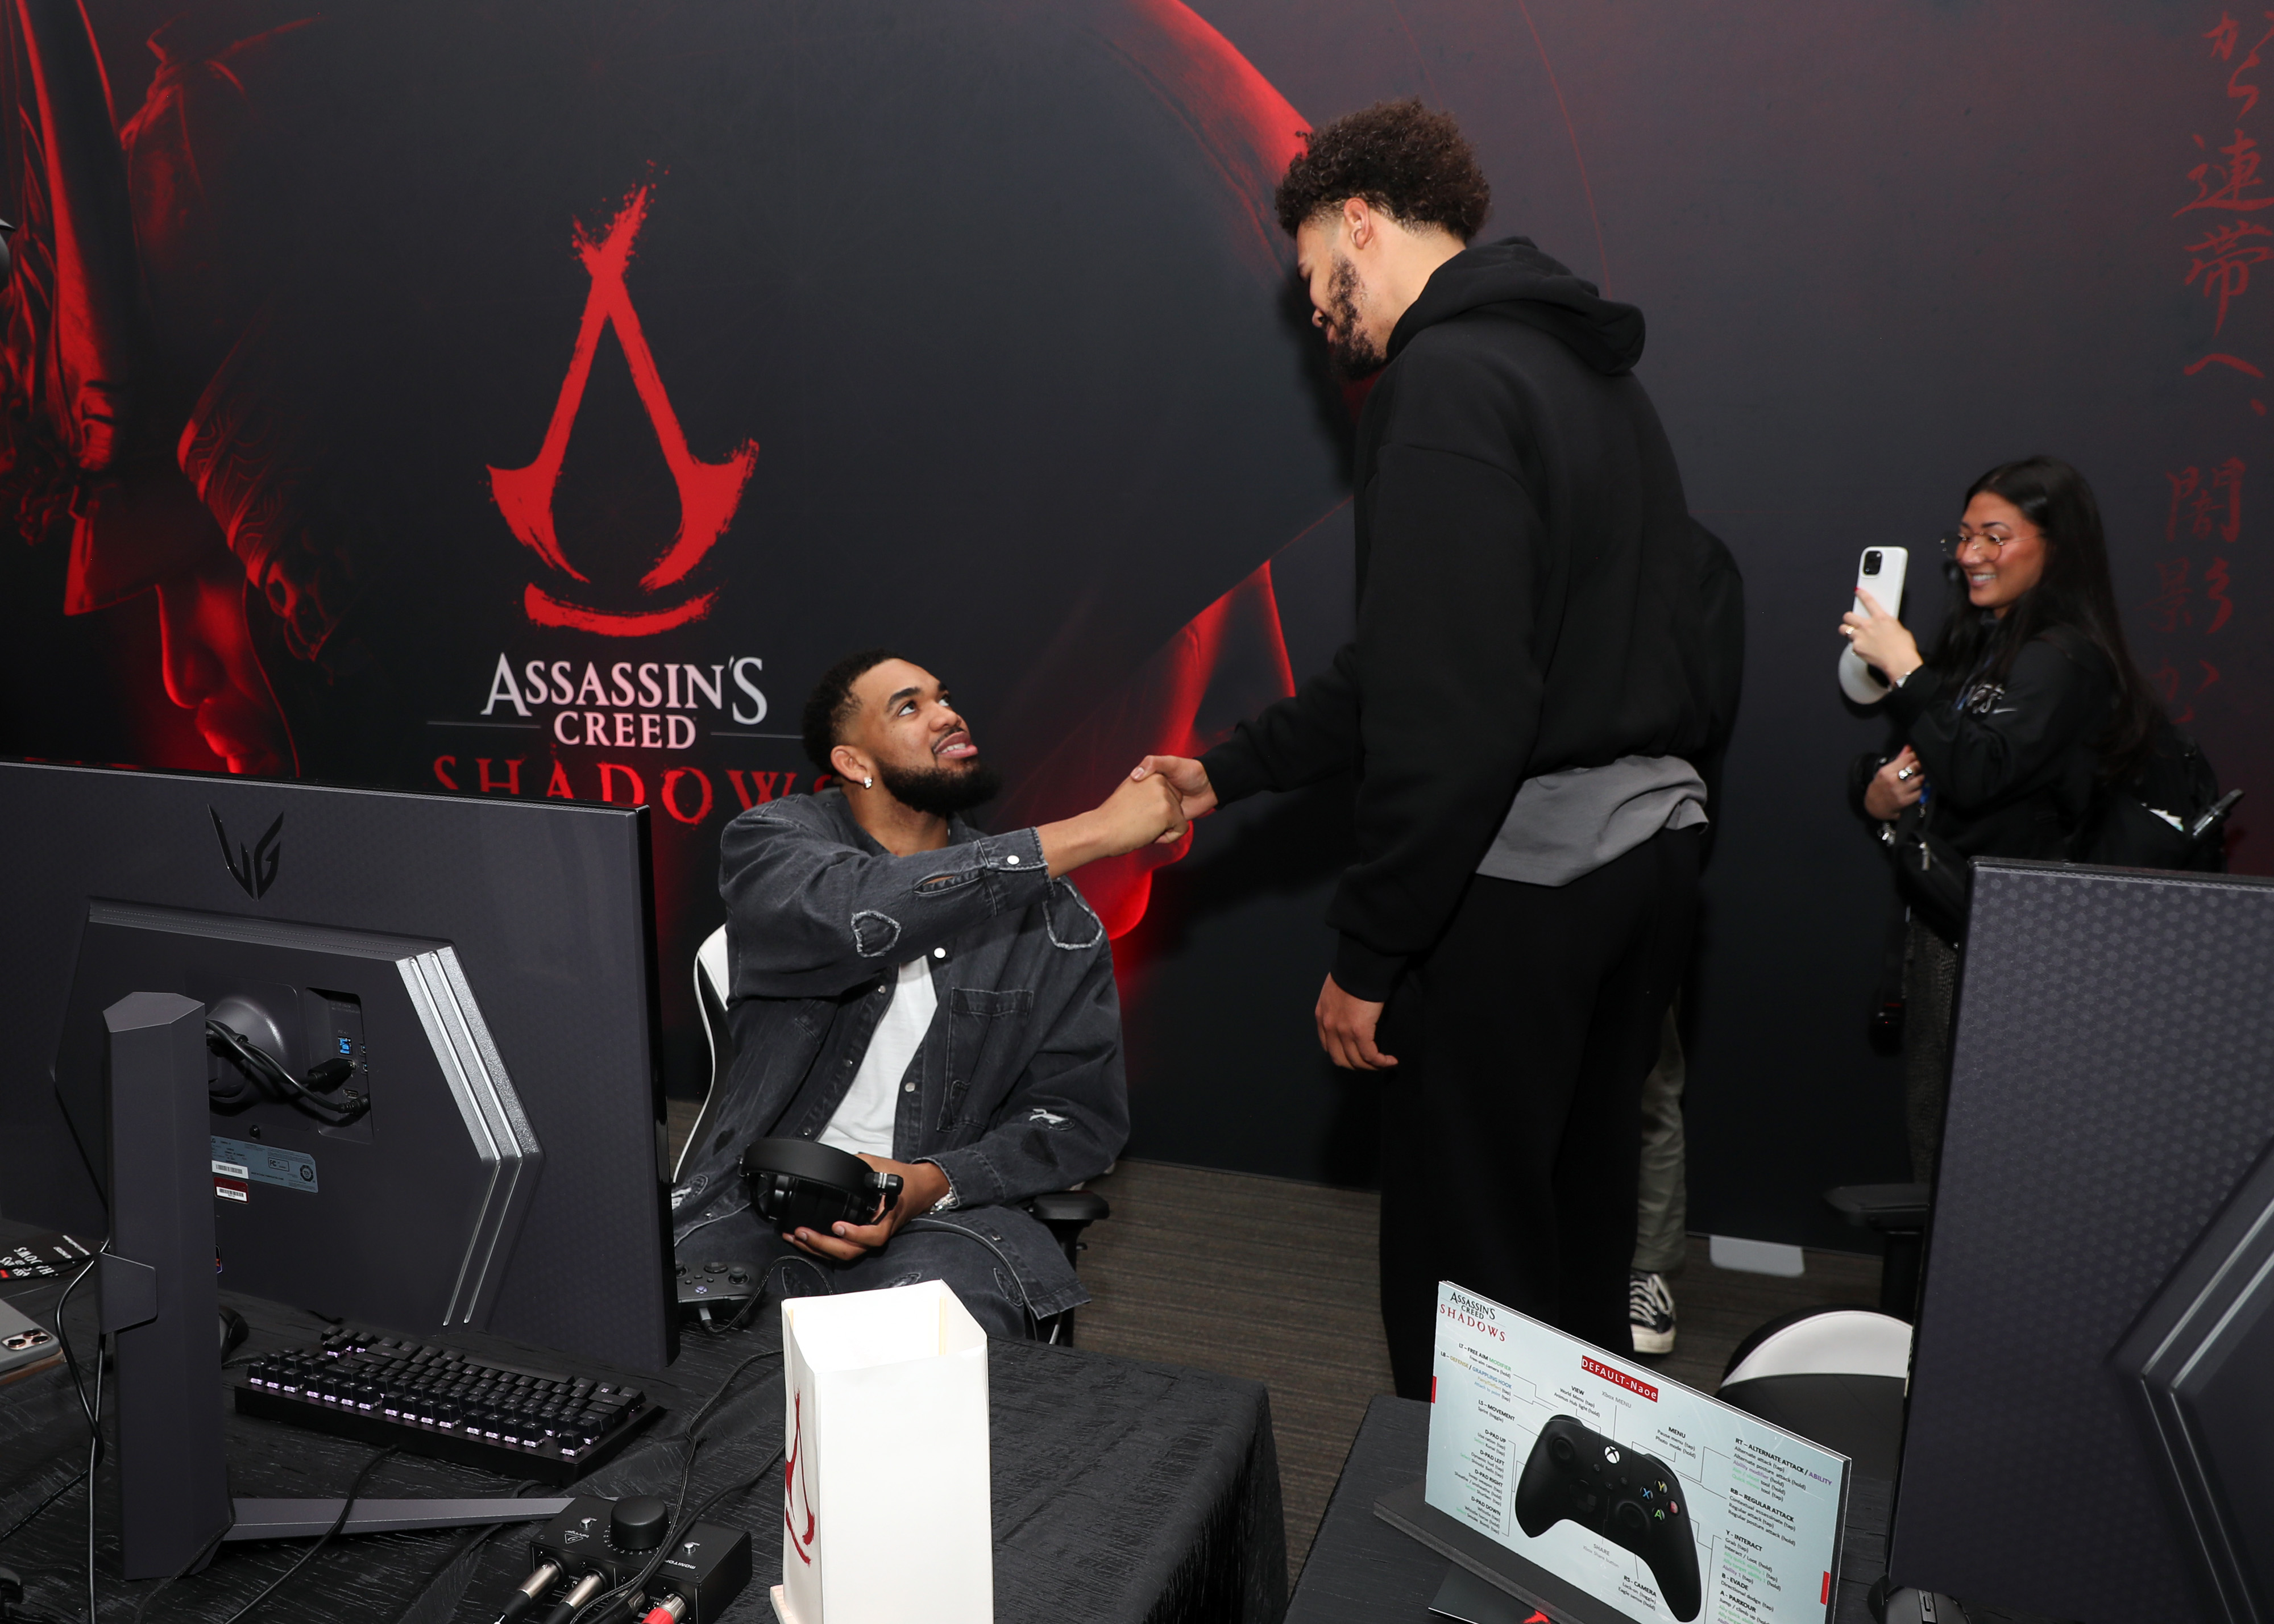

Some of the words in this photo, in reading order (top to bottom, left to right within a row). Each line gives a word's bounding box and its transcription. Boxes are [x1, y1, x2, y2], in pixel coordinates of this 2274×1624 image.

[480, 652, 767, 725] ASSASSIN'S
[553, 711, 697, 750] CREED
[433, 755, 832, 824] SHADOW
[1461, 1305, 1484, 1319] CREED
[1439, 1303, 1505, 1341] SHADOWS
[1467, 1347, 1478, 1356] FREE
[1498, 1378, 1512, 1389] HOOK
[1581, 1357, 1657, 1399] DEFAULT-Naoe
[1571, 1385, 1584, 1395] VIEW
[1615, 1397, 1632, 1409] MENU
[1487, 1404, 1515, 1421] MOVEMENT
[1668, 1426, 1686, 1439] MENU
[1748, 1444, 1781, 1463] ALTERNATE
[1782, 1459, 1804, 1473] ATTACK
[1808, 1472, 1832, 1486] ABILITY
[1744, 1494, 1771, 1511] REGULAR
[1771, 1507, 1794, 1523] ATTACK
[1734, 1534, 1762, 1552] INTERACT
[1634, 1581, 1657, 1597] CAMERA
[1730, 1577, 1749, 1591] EVADE
[1729, 1594, 1756, 1613] PARKOUR
